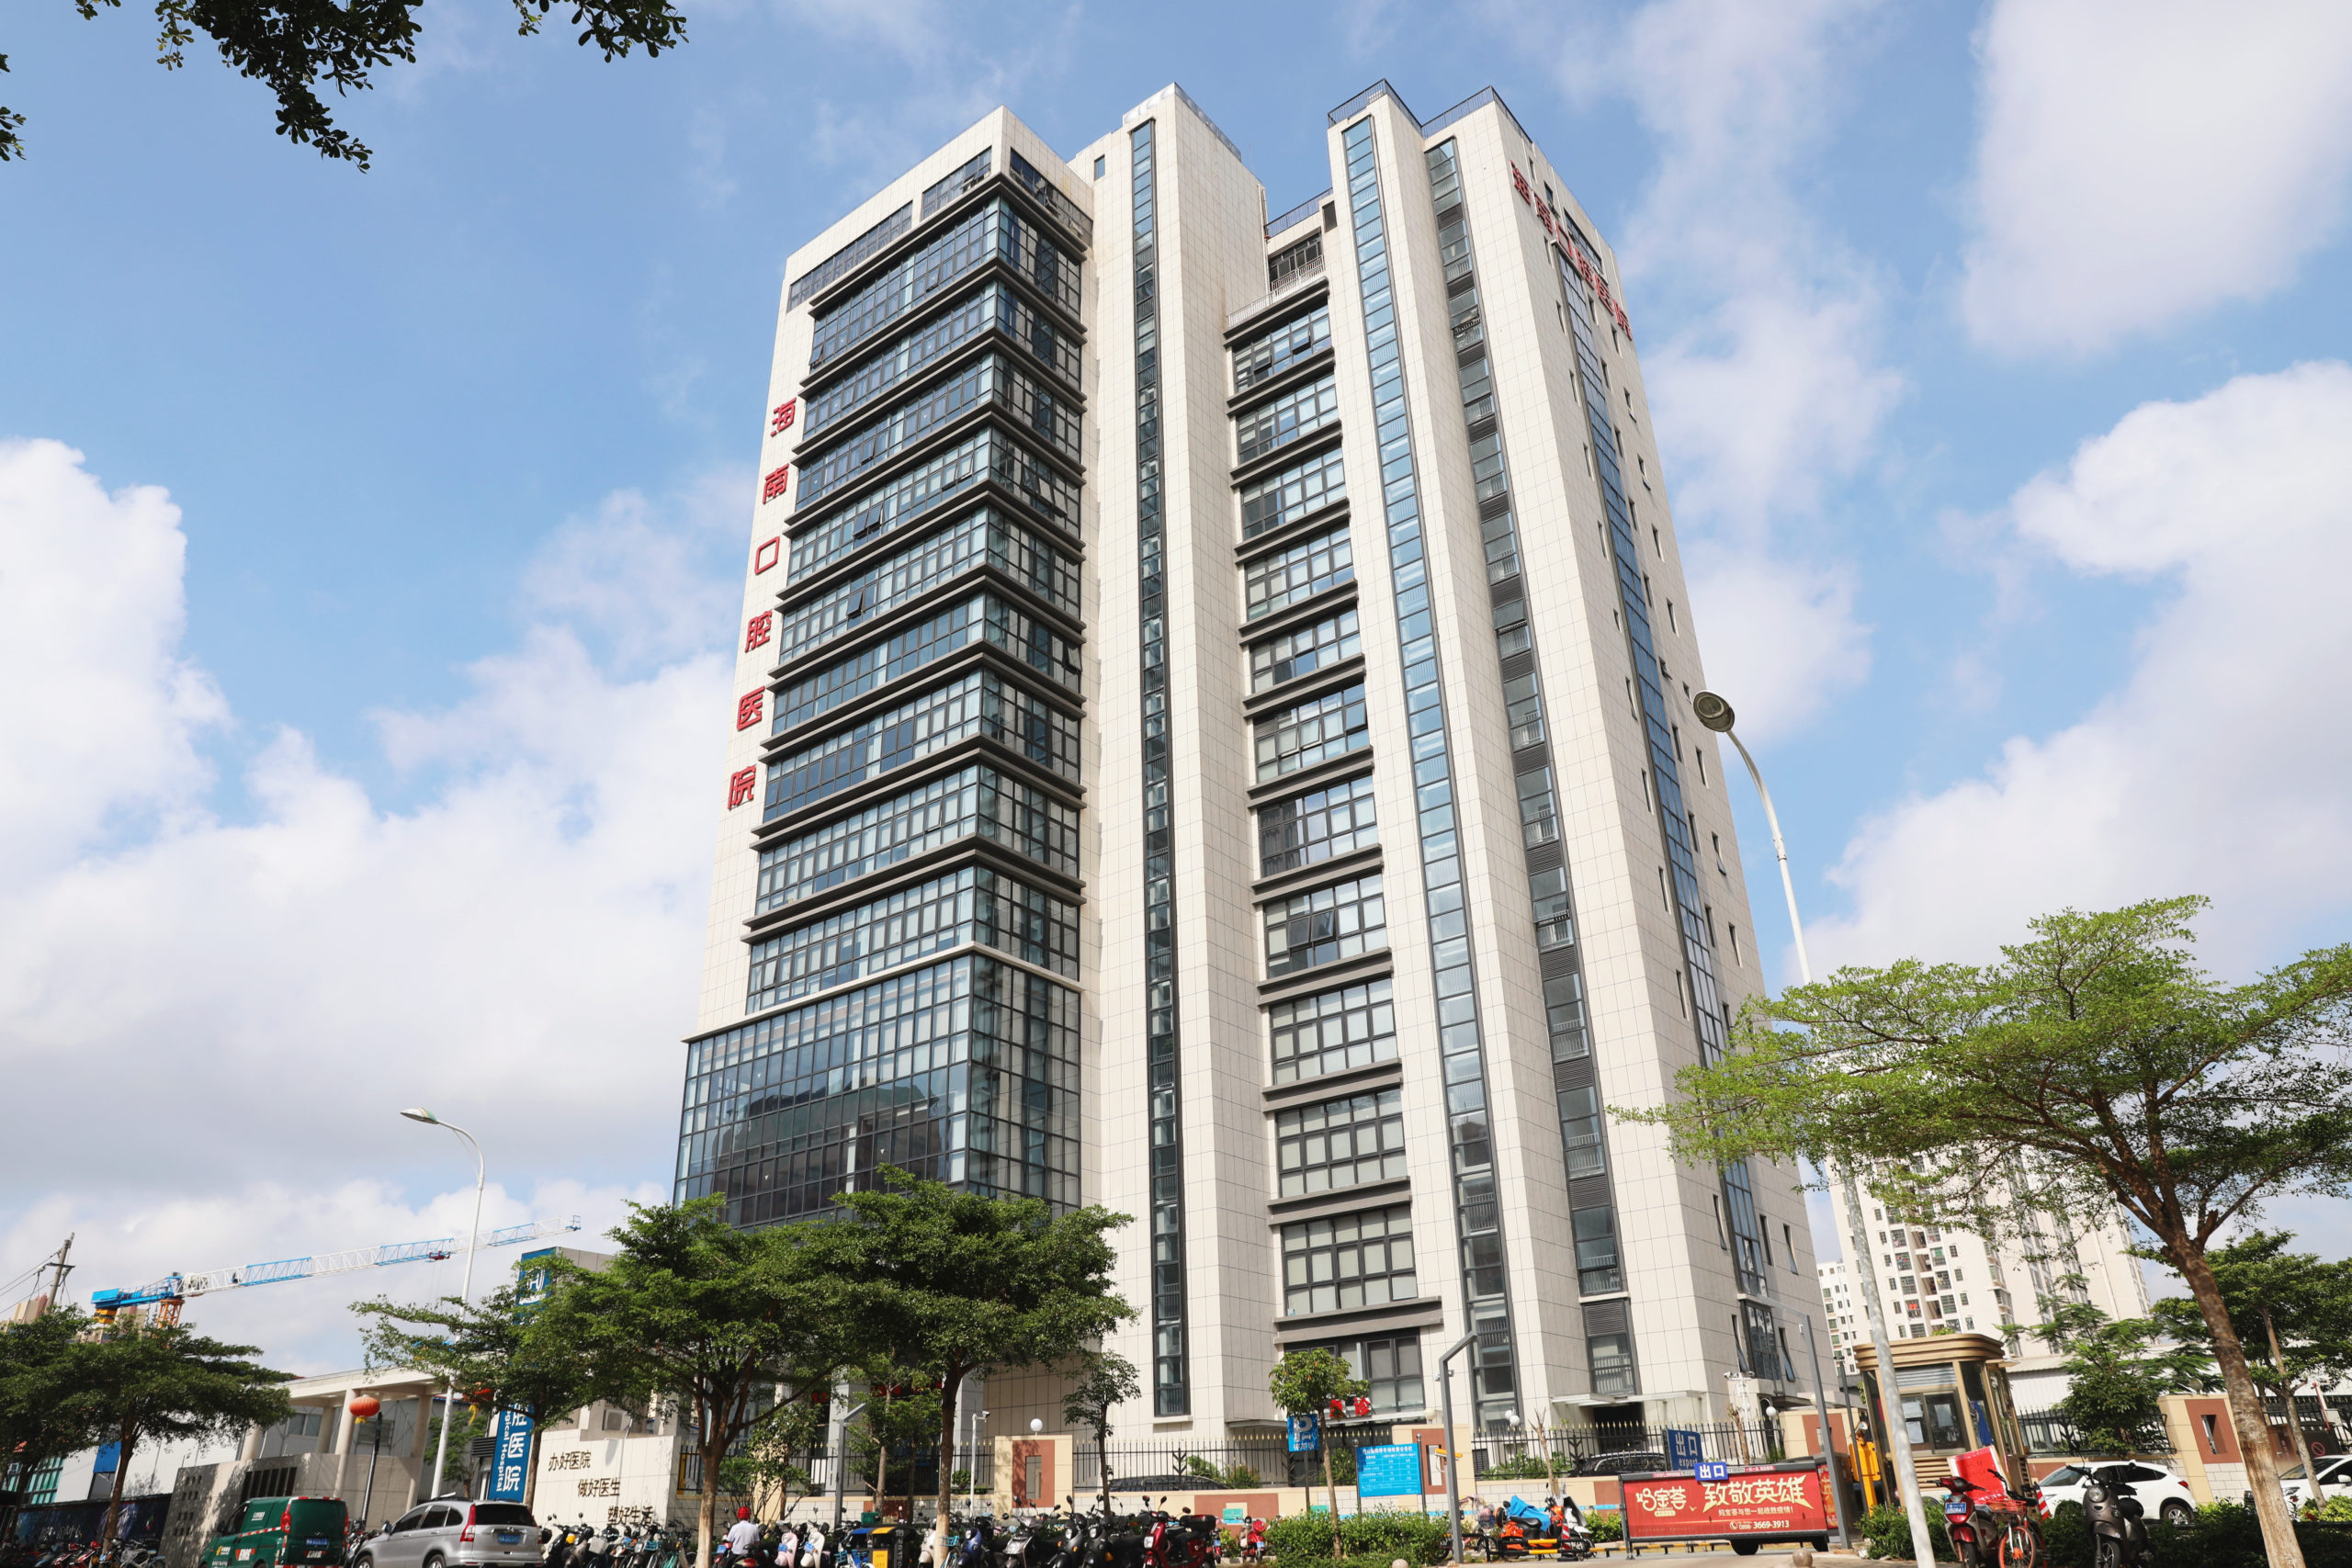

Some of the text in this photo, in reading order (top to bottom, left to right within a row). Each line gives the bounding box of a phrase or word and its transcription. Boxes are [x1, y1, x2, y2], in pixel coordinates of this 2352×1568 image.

[727, 397, 797, 810] 海南口腔医院
[1675, 1432, 1699, 1457] 出口
[496, 1443, 508, 1492] Hospital
[548, 1450, 592, 1472] 办好医院
[1700, 1464, 1725, 1479] 出口
[578, 1477, 621, 1498] 做好医生
[1702, 1473, 1815, 1514] 致敬英雄
[606, 1505, 655, 1529] 塑好生活
[1753, 1520, 1790, 1529] 3669-3913
